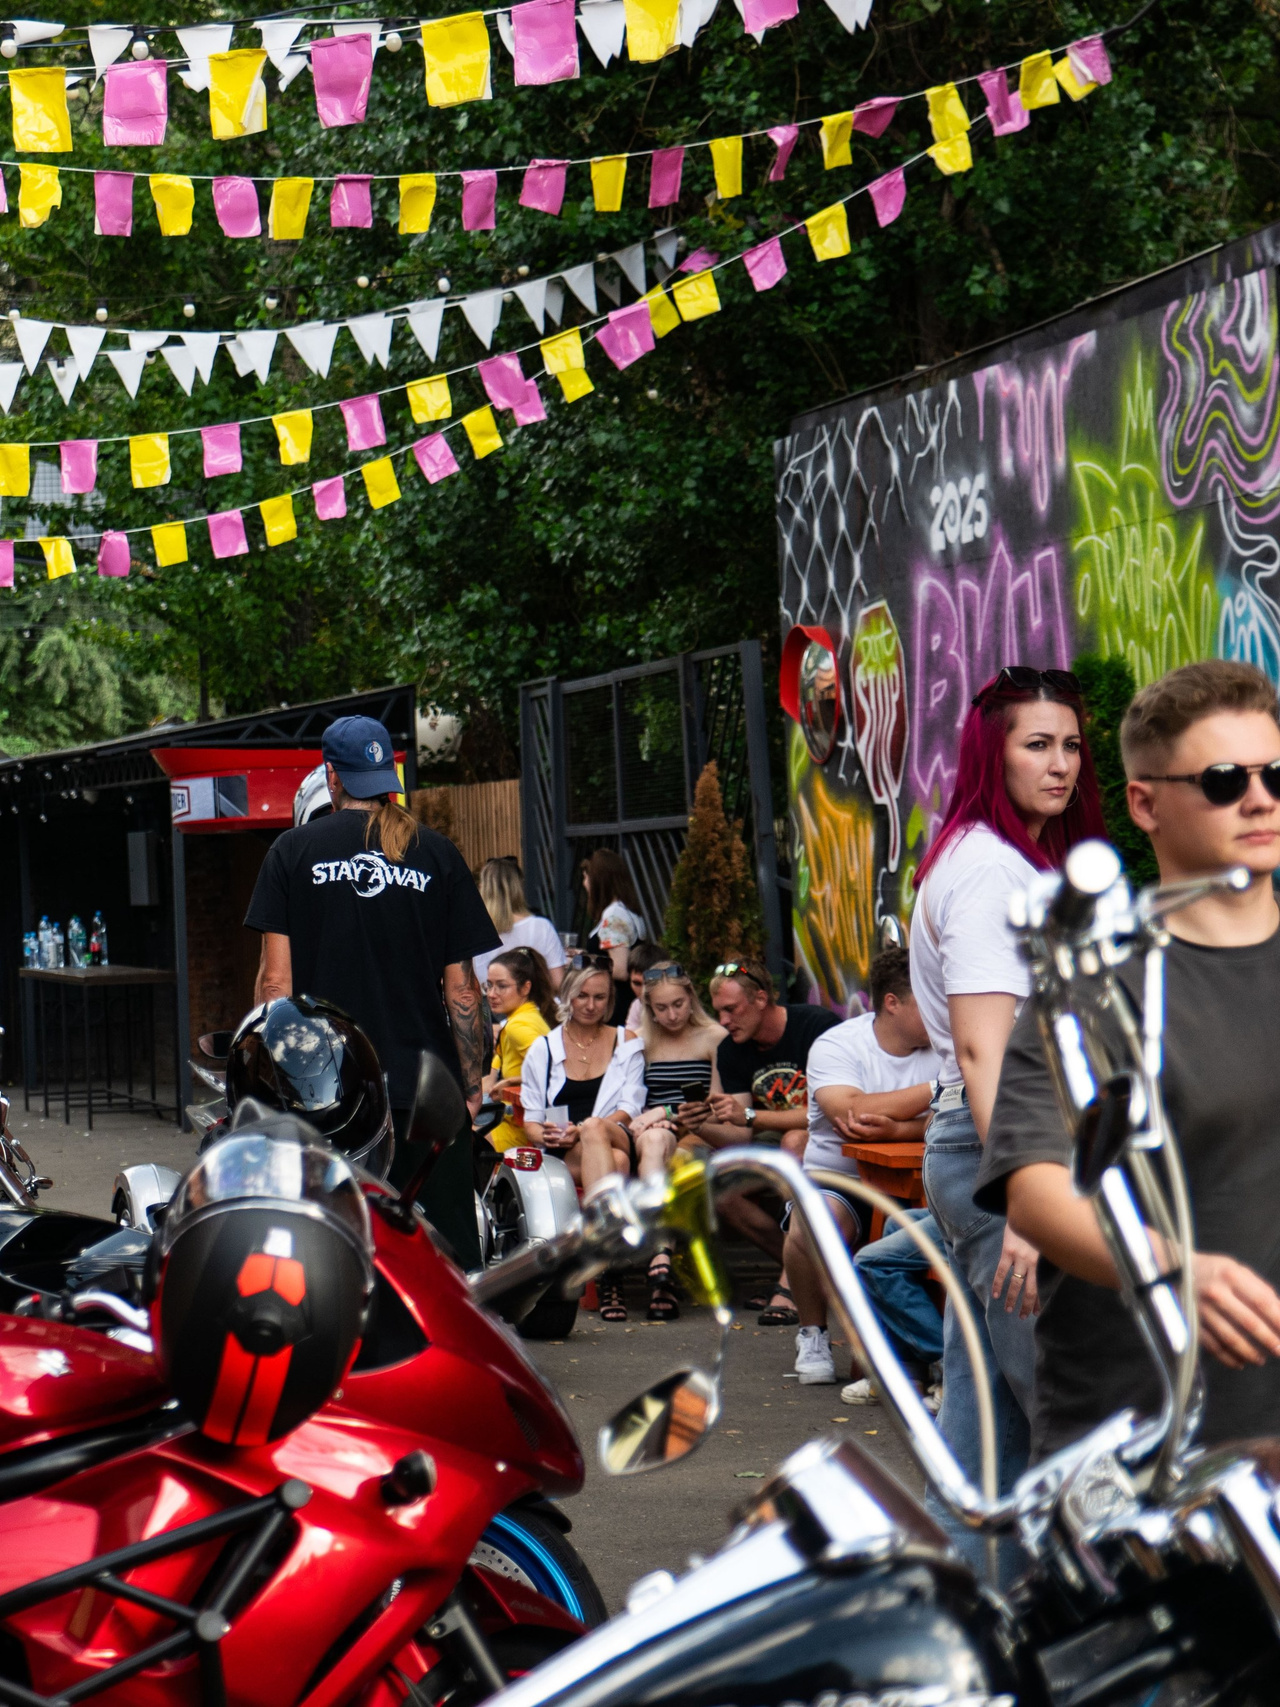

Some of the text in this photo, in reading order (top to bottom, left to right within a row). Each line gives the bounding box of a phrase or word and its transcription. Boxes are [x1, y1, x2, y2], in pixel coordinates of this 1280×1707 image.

[930, 473, 988, 552] 2025
[312, 861, 431, 892] STAY AWAY
